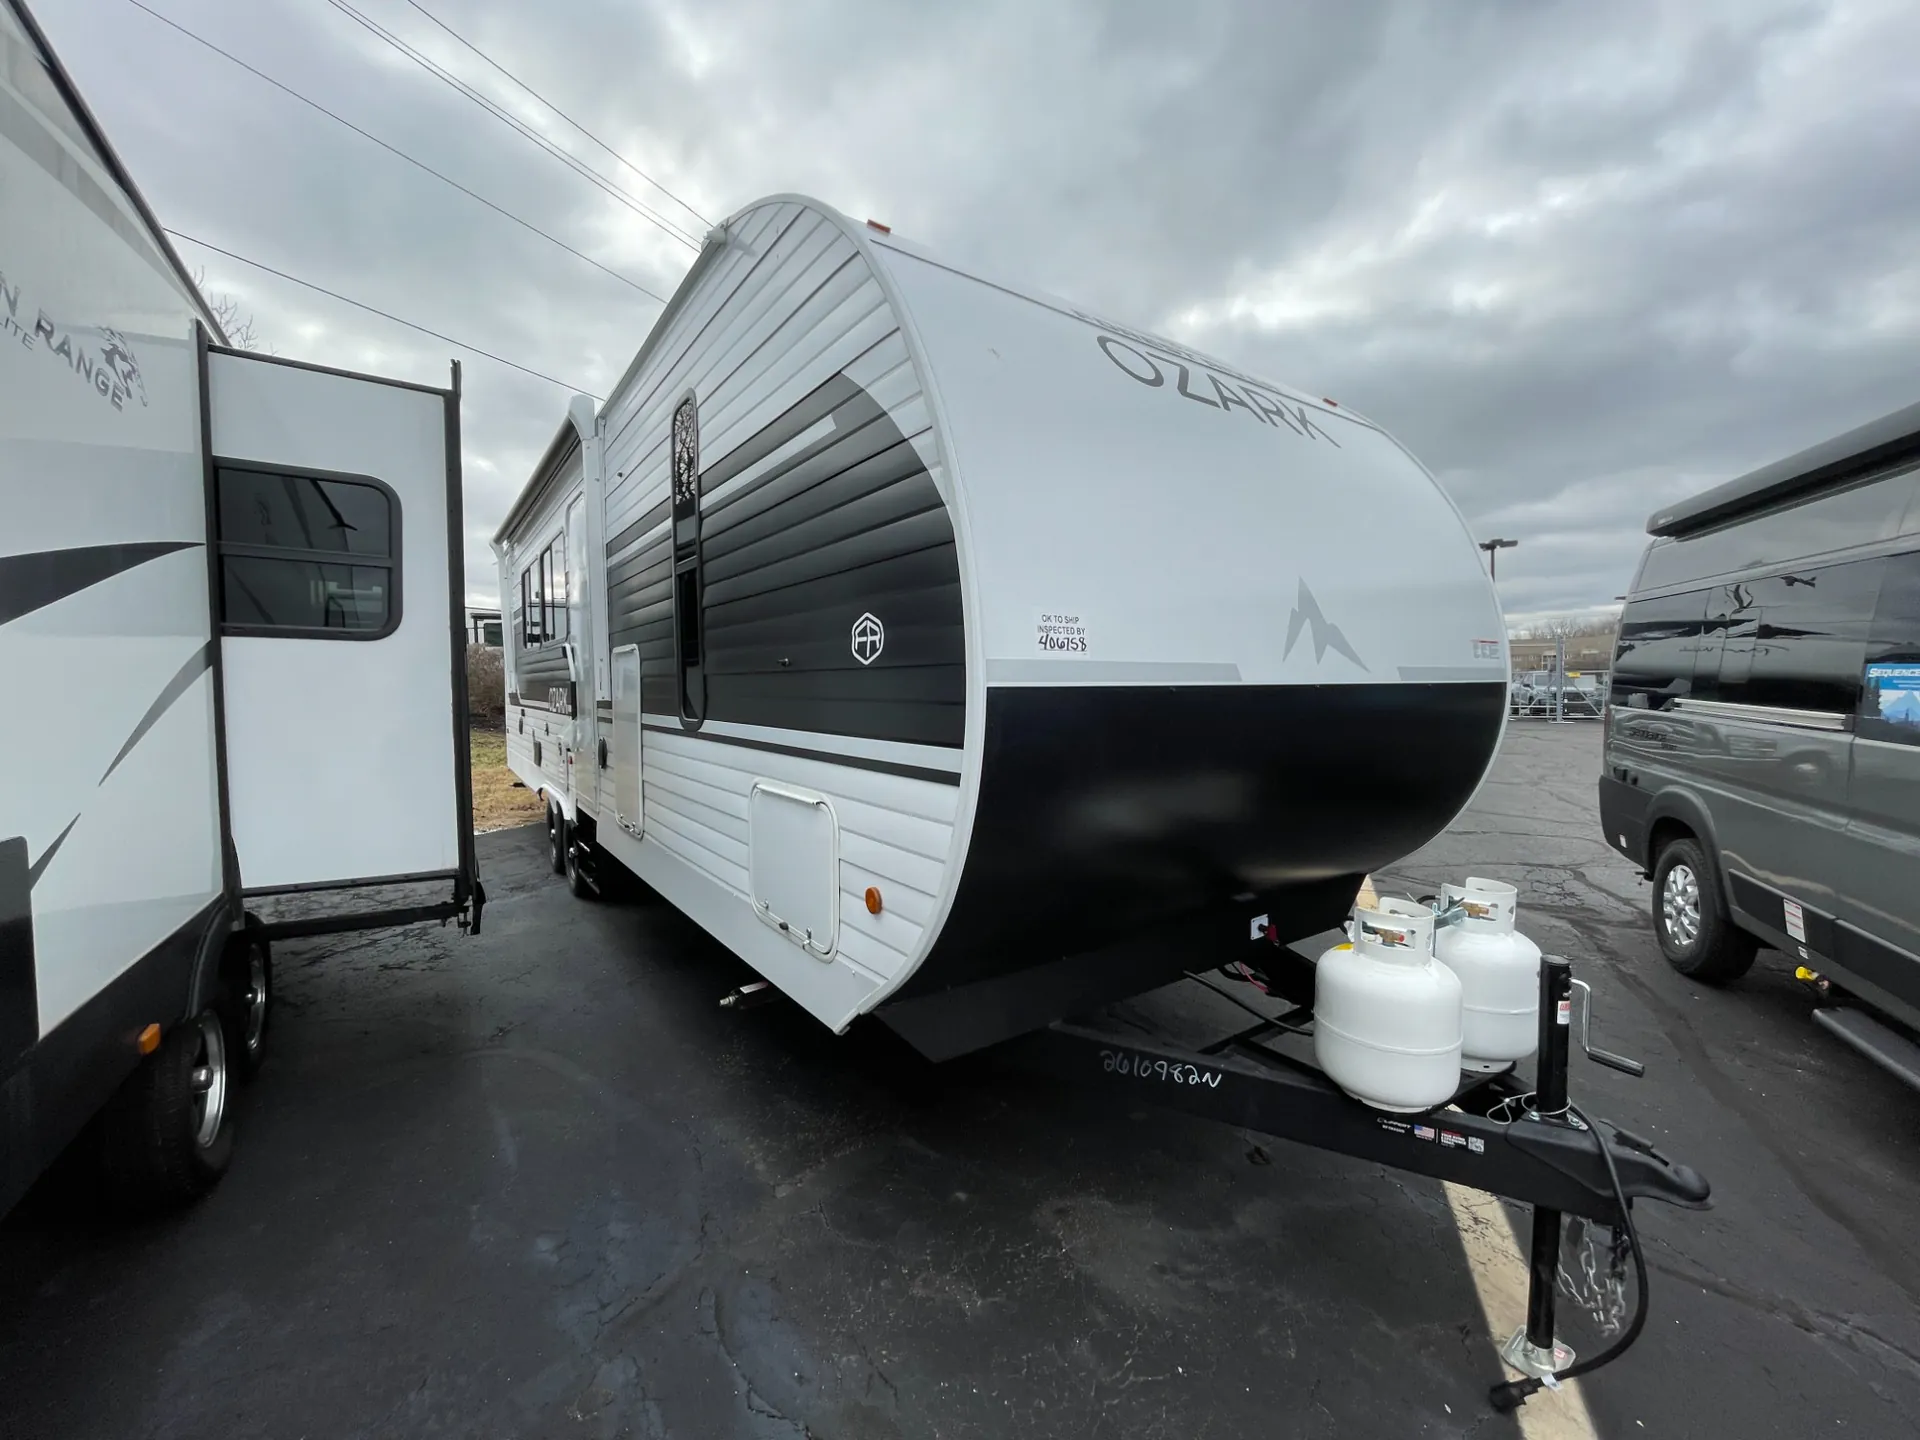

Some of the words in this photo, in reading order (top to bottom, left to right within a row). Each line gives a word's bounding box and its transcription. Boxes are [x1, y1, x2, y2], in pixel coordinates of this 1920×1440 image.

[35, 307, 125, 413] RANGE
[1096, 335, 1342, 449] OZARK
[1042, 614, 1052, 622] OK
[1054, 615, 1063, 623] TO
[1064, 616, 1079, 624] SHIP
[1038, 625, 1075, 635] INSPECTED
[1077, 627, 1085, 635] BY
[1038, 633, 1087, 652] 406758
